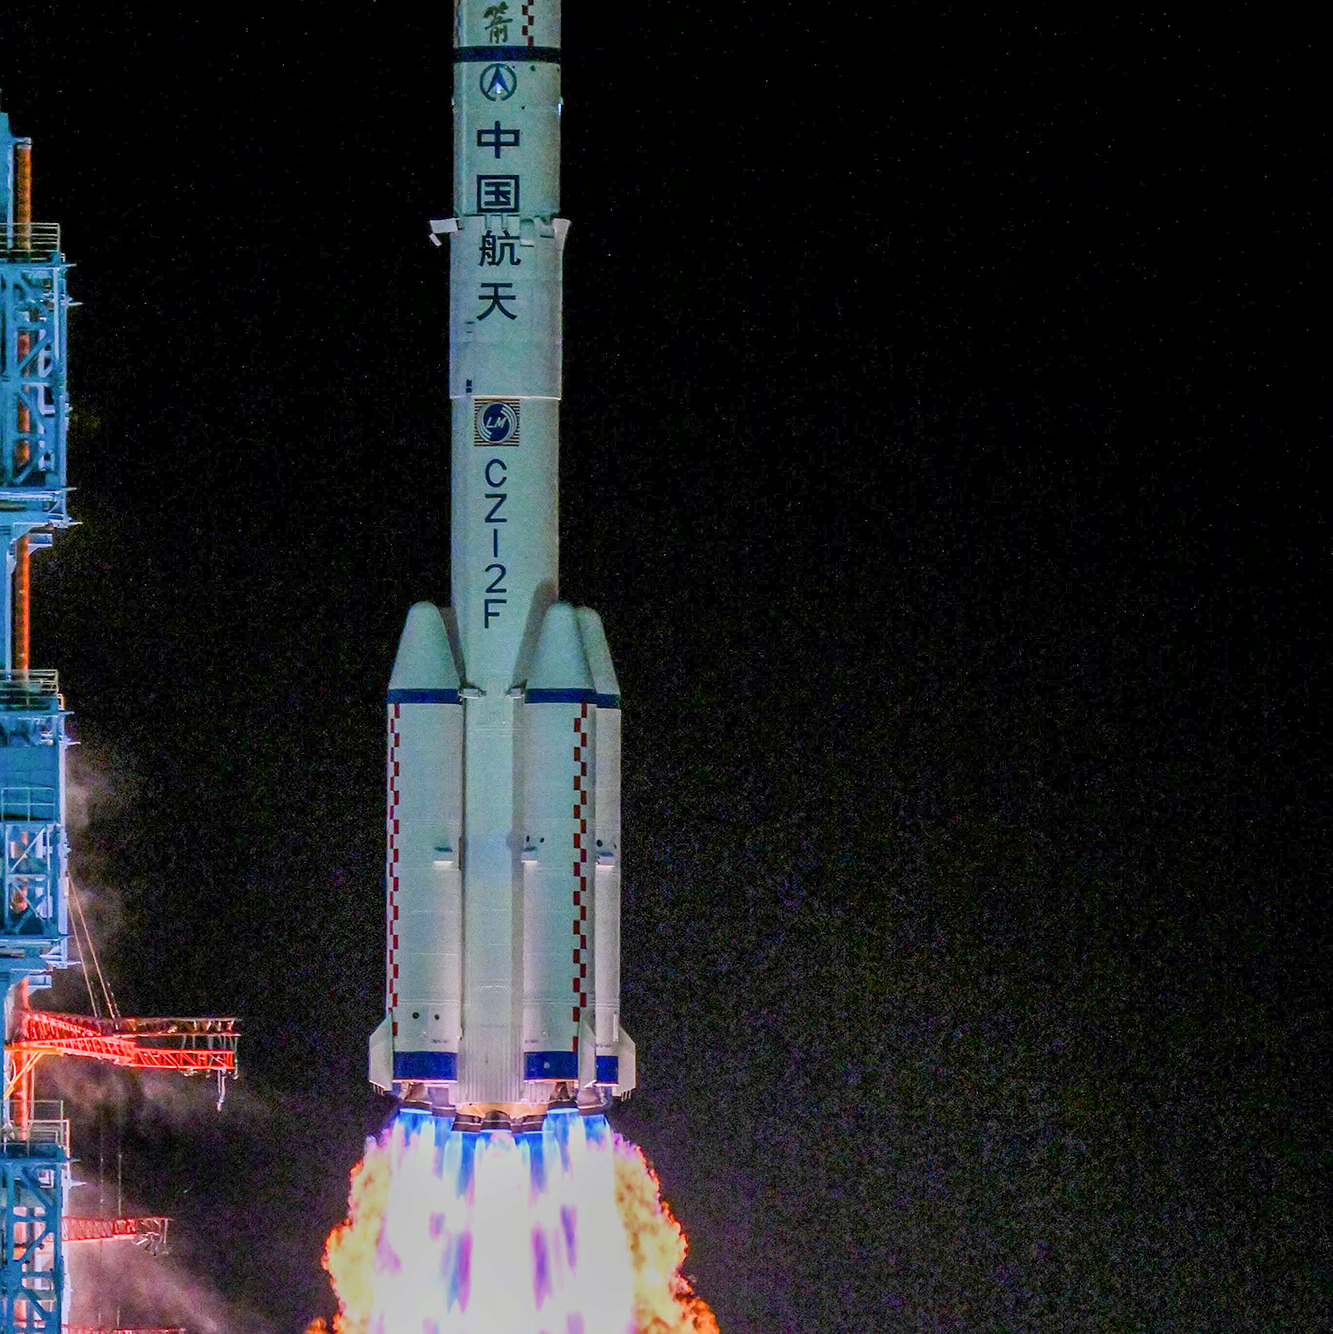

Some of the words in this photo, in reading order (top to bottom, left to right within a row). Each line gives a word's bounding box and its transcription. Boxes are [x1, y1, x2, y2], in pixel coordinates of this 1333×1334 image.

[476, 120, 521, 321] 中国航天
[486, 416, 507, 428] LM
